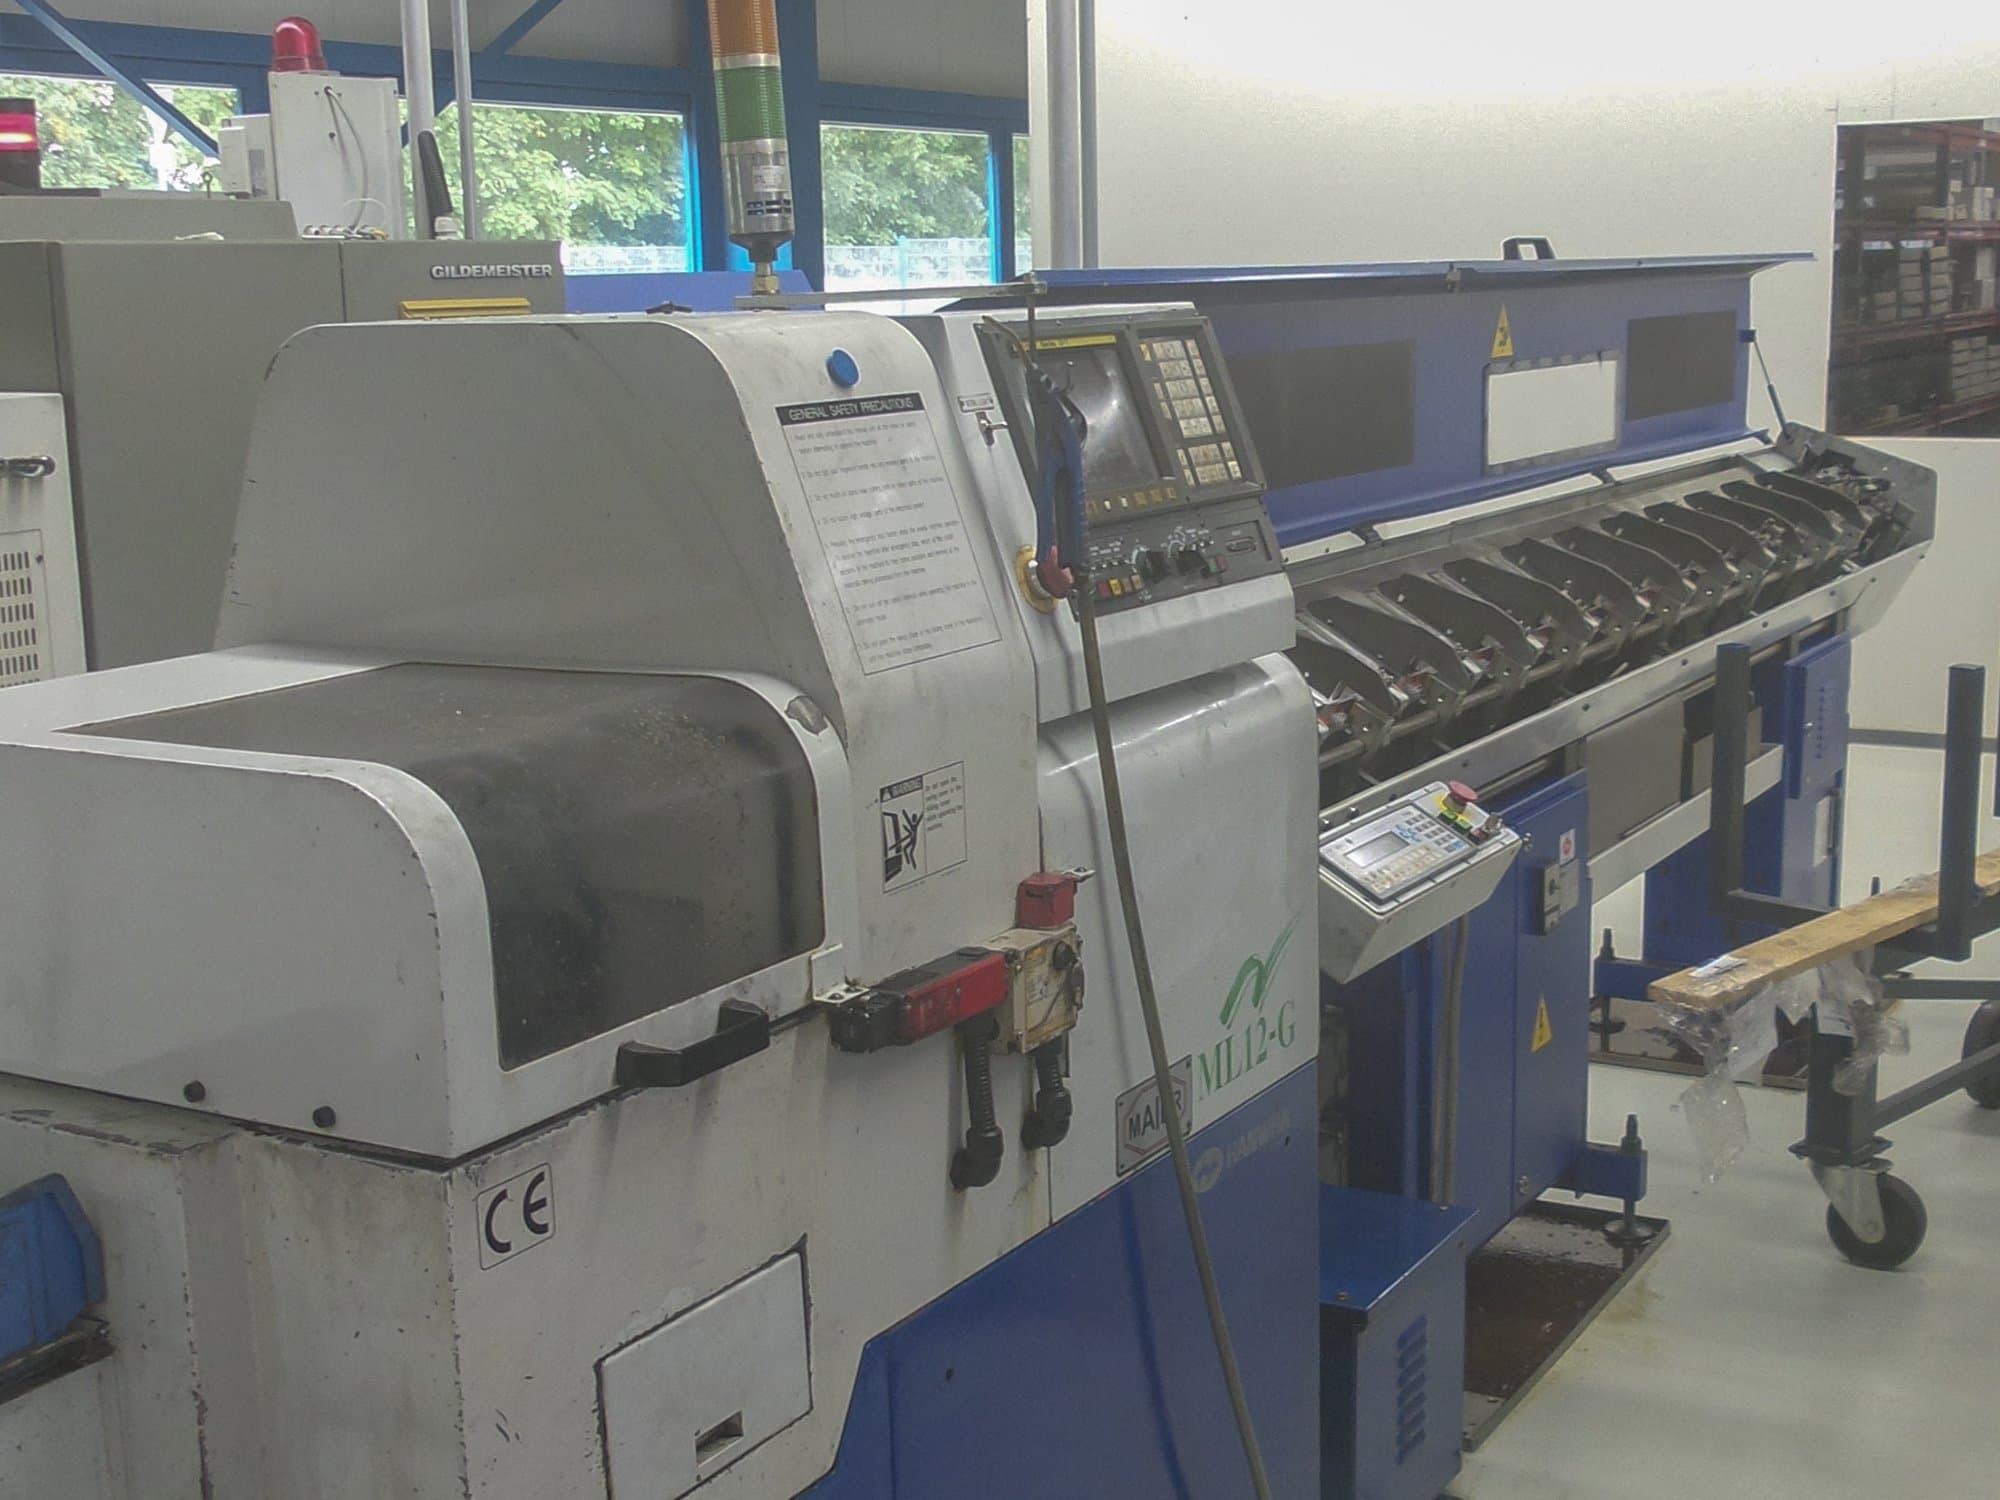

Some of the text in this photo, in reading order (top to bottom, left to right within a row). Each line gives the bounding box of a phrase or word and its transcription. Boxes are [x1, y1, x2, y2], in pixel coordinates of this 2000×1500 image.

[431, 263, 553, 279] GILDEMEISTER
[789, 397, 914, 421] GENERAL SAFETY PRECAUTIONS
[1197, 999, 1297, 1101] ML12-G
[484, 1170, 550, 1254] CE
